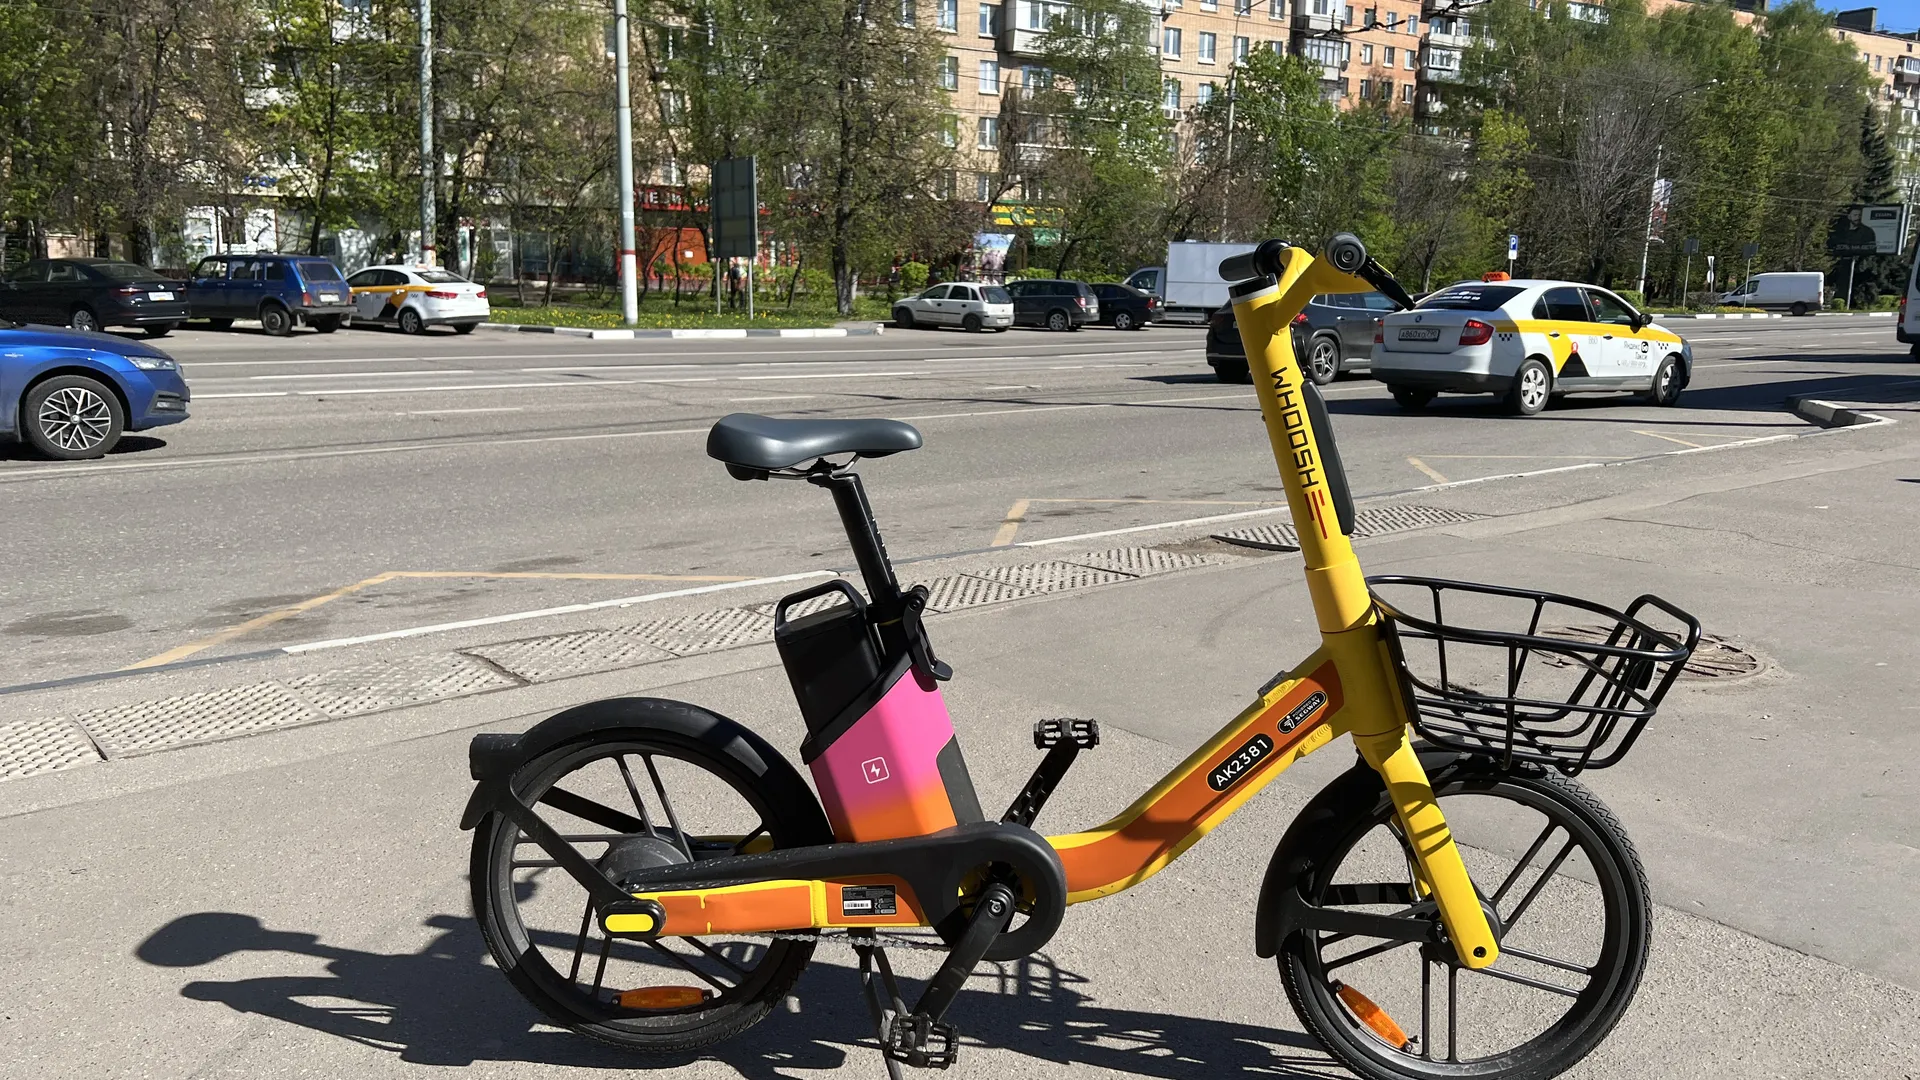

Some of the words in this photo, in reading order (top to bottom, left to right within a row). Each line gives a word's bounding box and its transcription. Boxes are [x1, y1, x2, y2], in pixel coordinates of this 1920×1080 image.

[1271, 366, 1319, 489] WHOOSH
[1295, 698, 1320, 720] SEGWAY
[1215, 739, 1268, 786] AK2381
